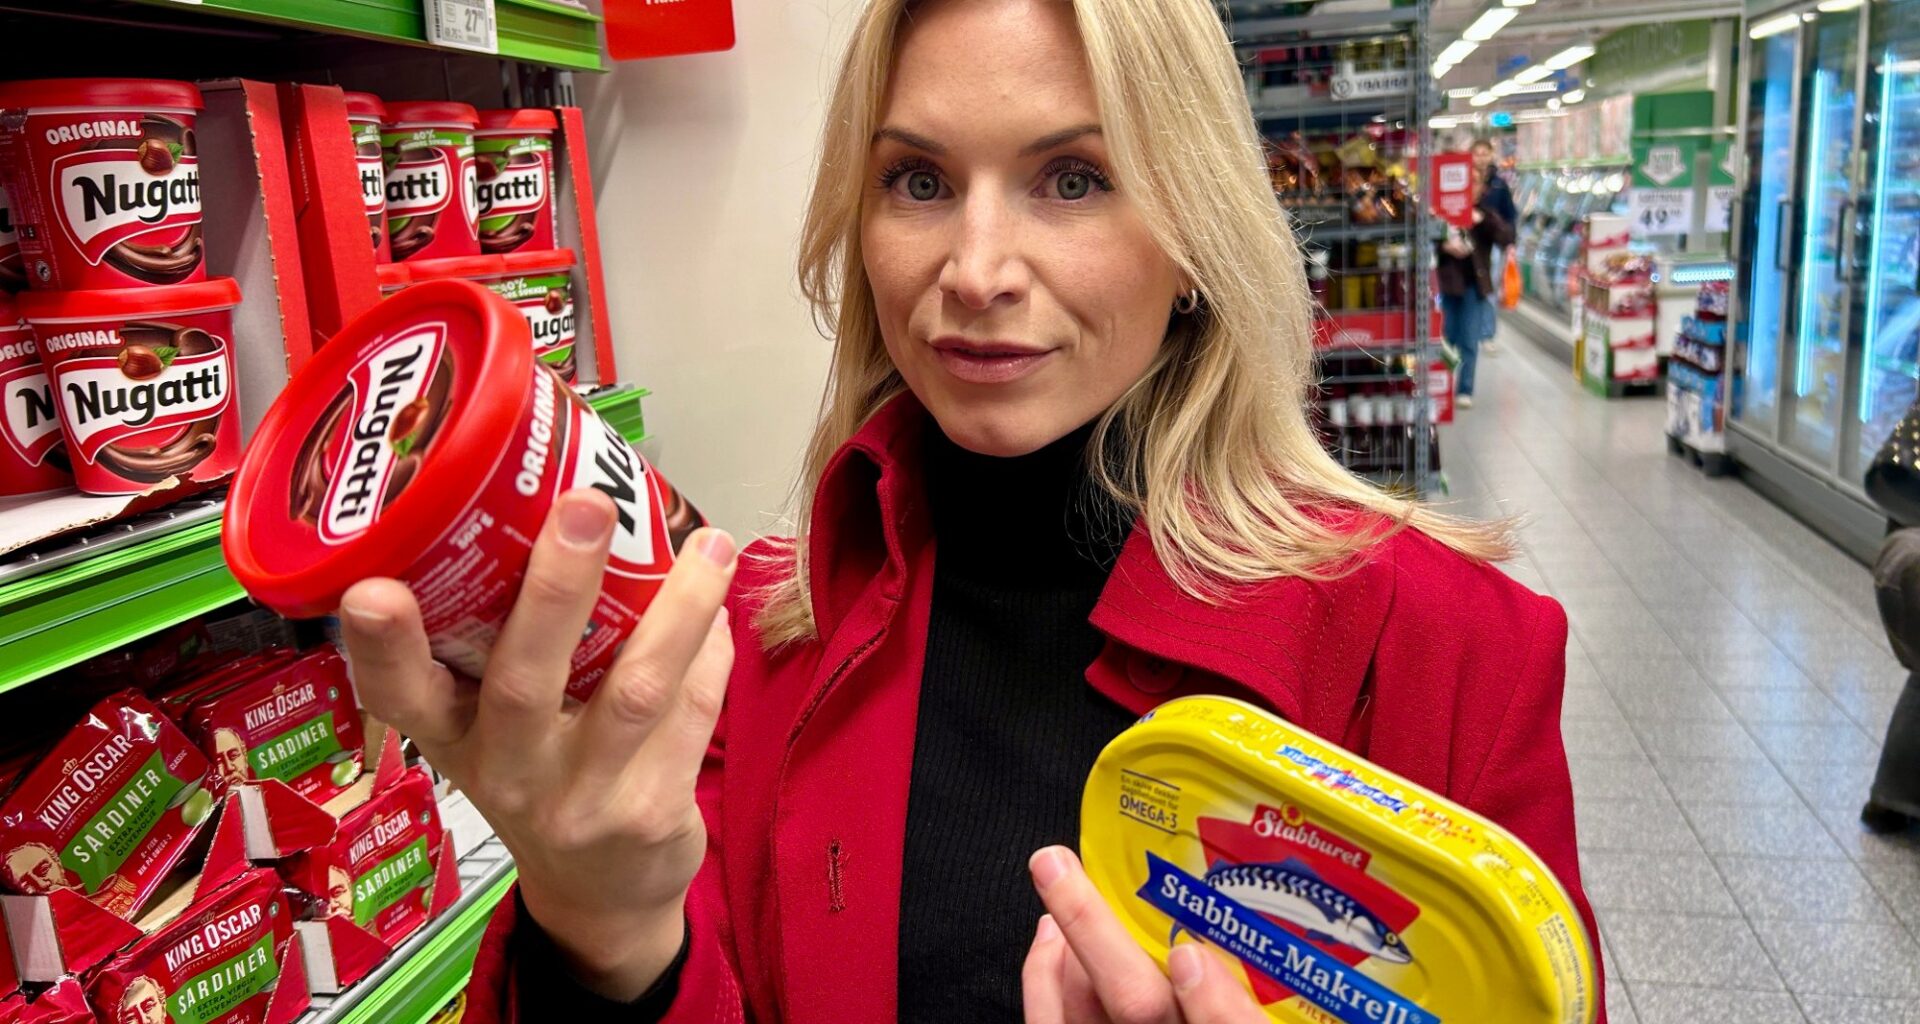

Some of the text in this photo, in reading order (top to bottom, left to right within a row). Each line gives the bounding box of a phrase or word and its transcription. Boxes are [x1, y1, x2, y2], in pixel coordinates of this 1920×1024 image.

[46, 120, 142, 145] ORIGINAL
[72, 171, 200, 223] Nugatt
[385, 171, 440, 202] atti
[476, 174, 539, 214] gatti
[46, 329, 121, 353] ORIGINAL
[67, 365, 222, 426] Nugatti
[335, 345, 423, 523] Nugatti
[515, 364, 555, 497] ORIGINAL
[245, 702, 276, 730] KING
[276, 683, 317, 716] OSCAR
[258, 721, 328, 769] SARDINER
[38, 734, 133, 830] KING OSCAR
[73, 769, 162, 863] SARDINER
[109, 826, 133, 850] EXTRA
[348, 834, 374, 865] KING
[374, 810, 412, 846] OSCAR
[1120, 794, 1177, 829] OMEGA-3
[1253, 810, 1363, 868] Stabburet
[356, 847, 422, 902] SARDINER
[165, 934, 205, 972] KING
[204, 904, 261, 949] OSCAR
[1207, 927, 1228, 944] DEN
[1229, 939, 1282, 975] ORIGINALE
[1284, 972, 1314, 993] SIDEN
[178, 946, 267, 1015] SARDINER
[197, 994, 225, 1012] EXTRA
[227, 976, 256, 995] VIRGIN
[199, 986, 251, 1020] OLIVENOLJE
